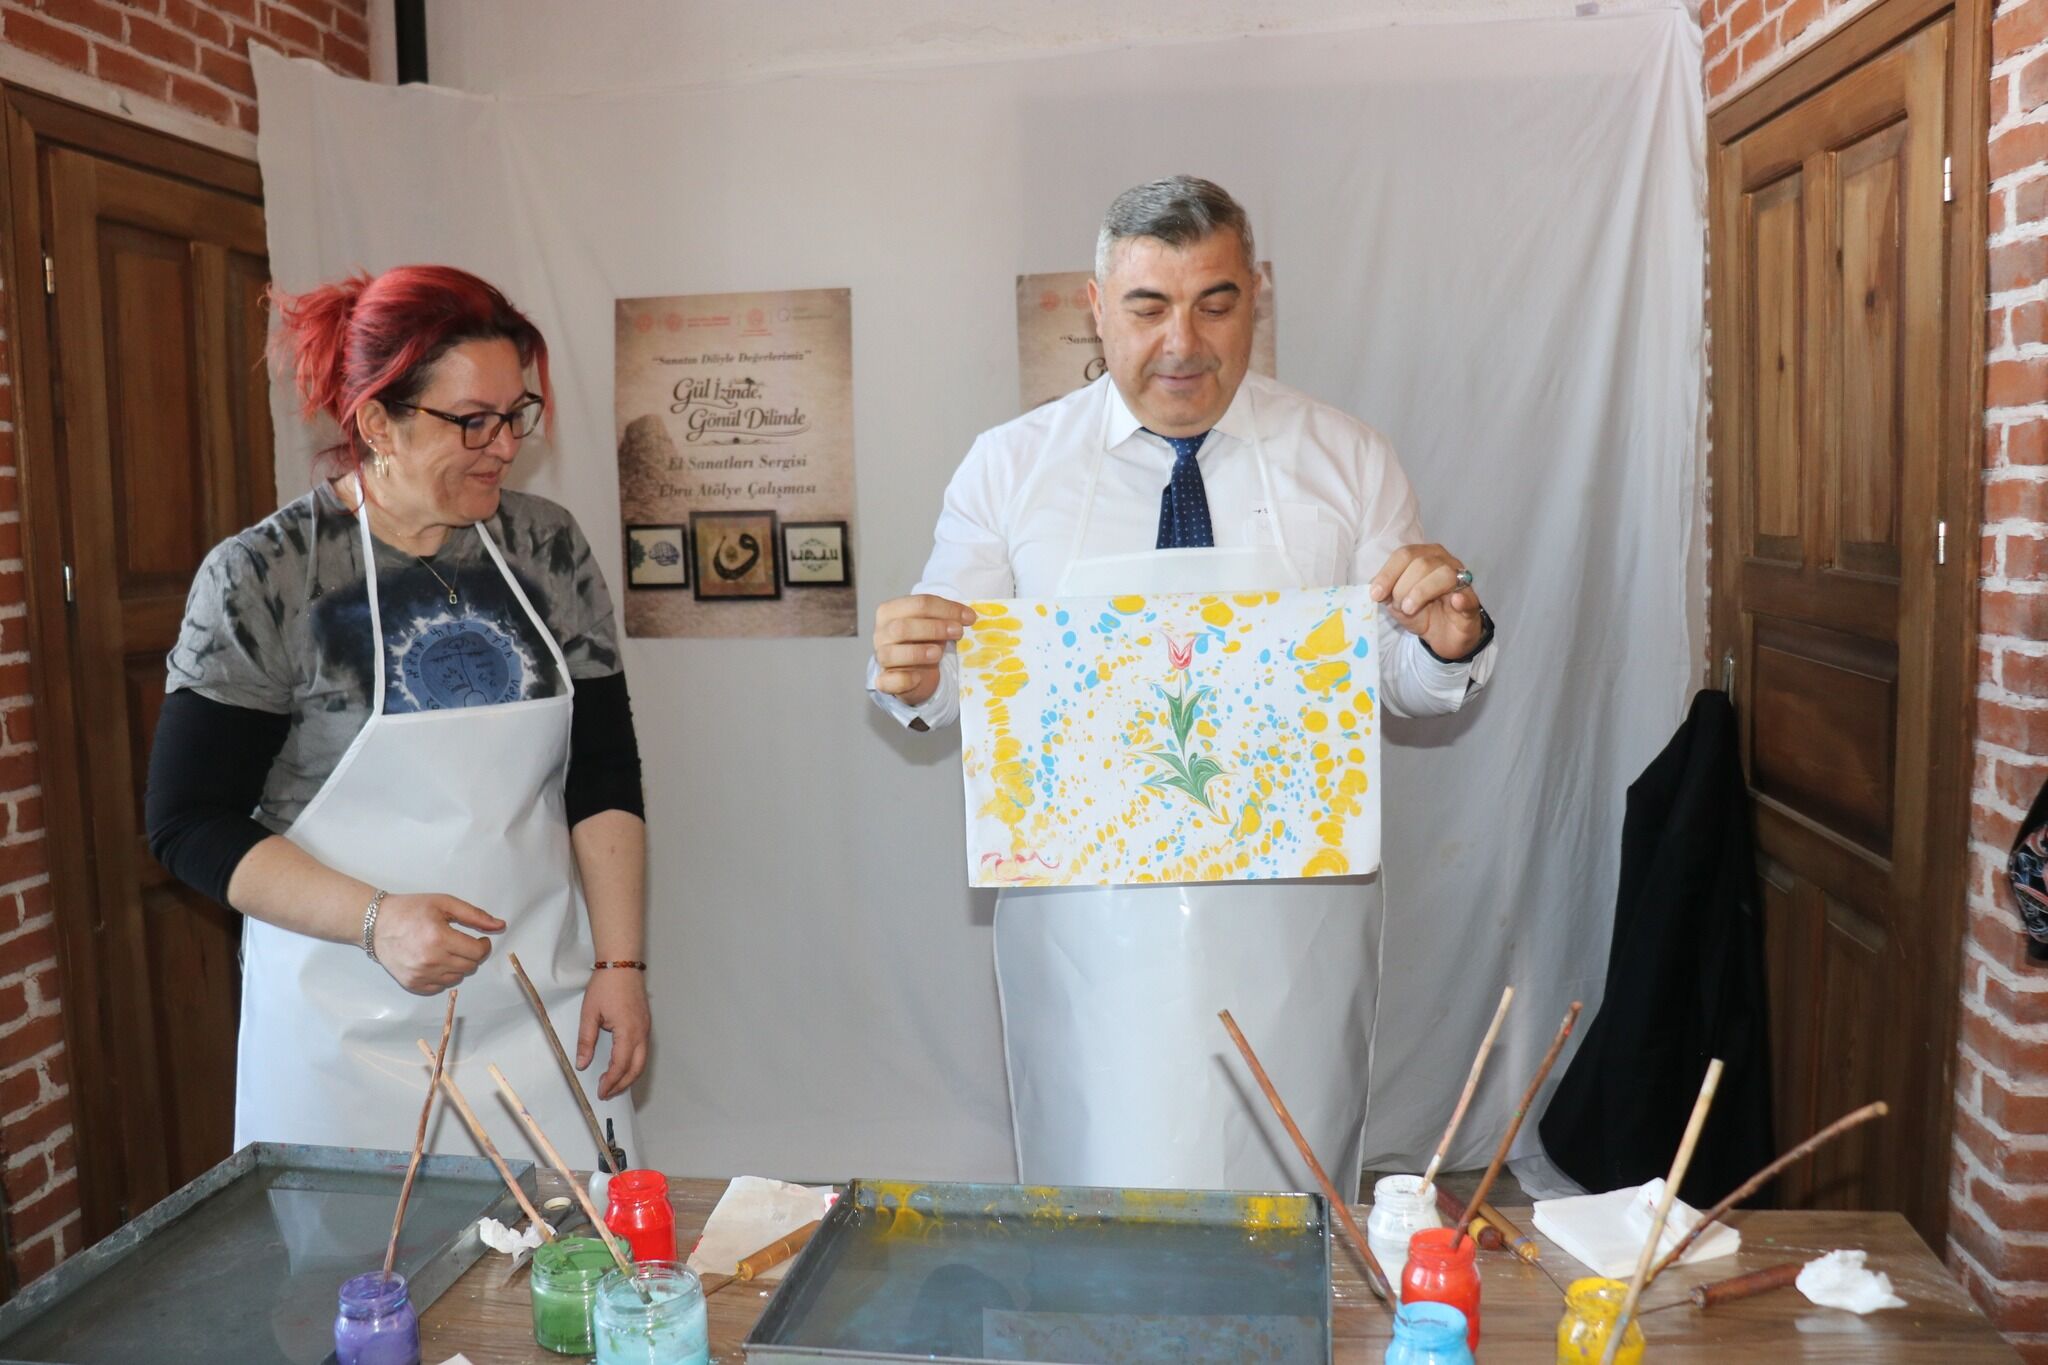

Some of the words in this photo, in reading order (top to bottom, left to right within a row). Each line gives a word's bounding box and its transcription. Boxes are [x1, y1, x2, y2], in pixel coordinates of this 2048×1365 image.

[670, 377, 711, 414] Gül
[686, 408, 741, 442] Gönül
[743, 407, 806, 430] Dilinde
[668, 457, 684, 471] El
[687, 456, 754, 471] Sanatları
[759, 454, 807, 473] Sergisi
[659, 484, 693, 499] Ebru
[699, 483, 742, 500] Atölye
[747, 481, 817, 500] Çalışması
